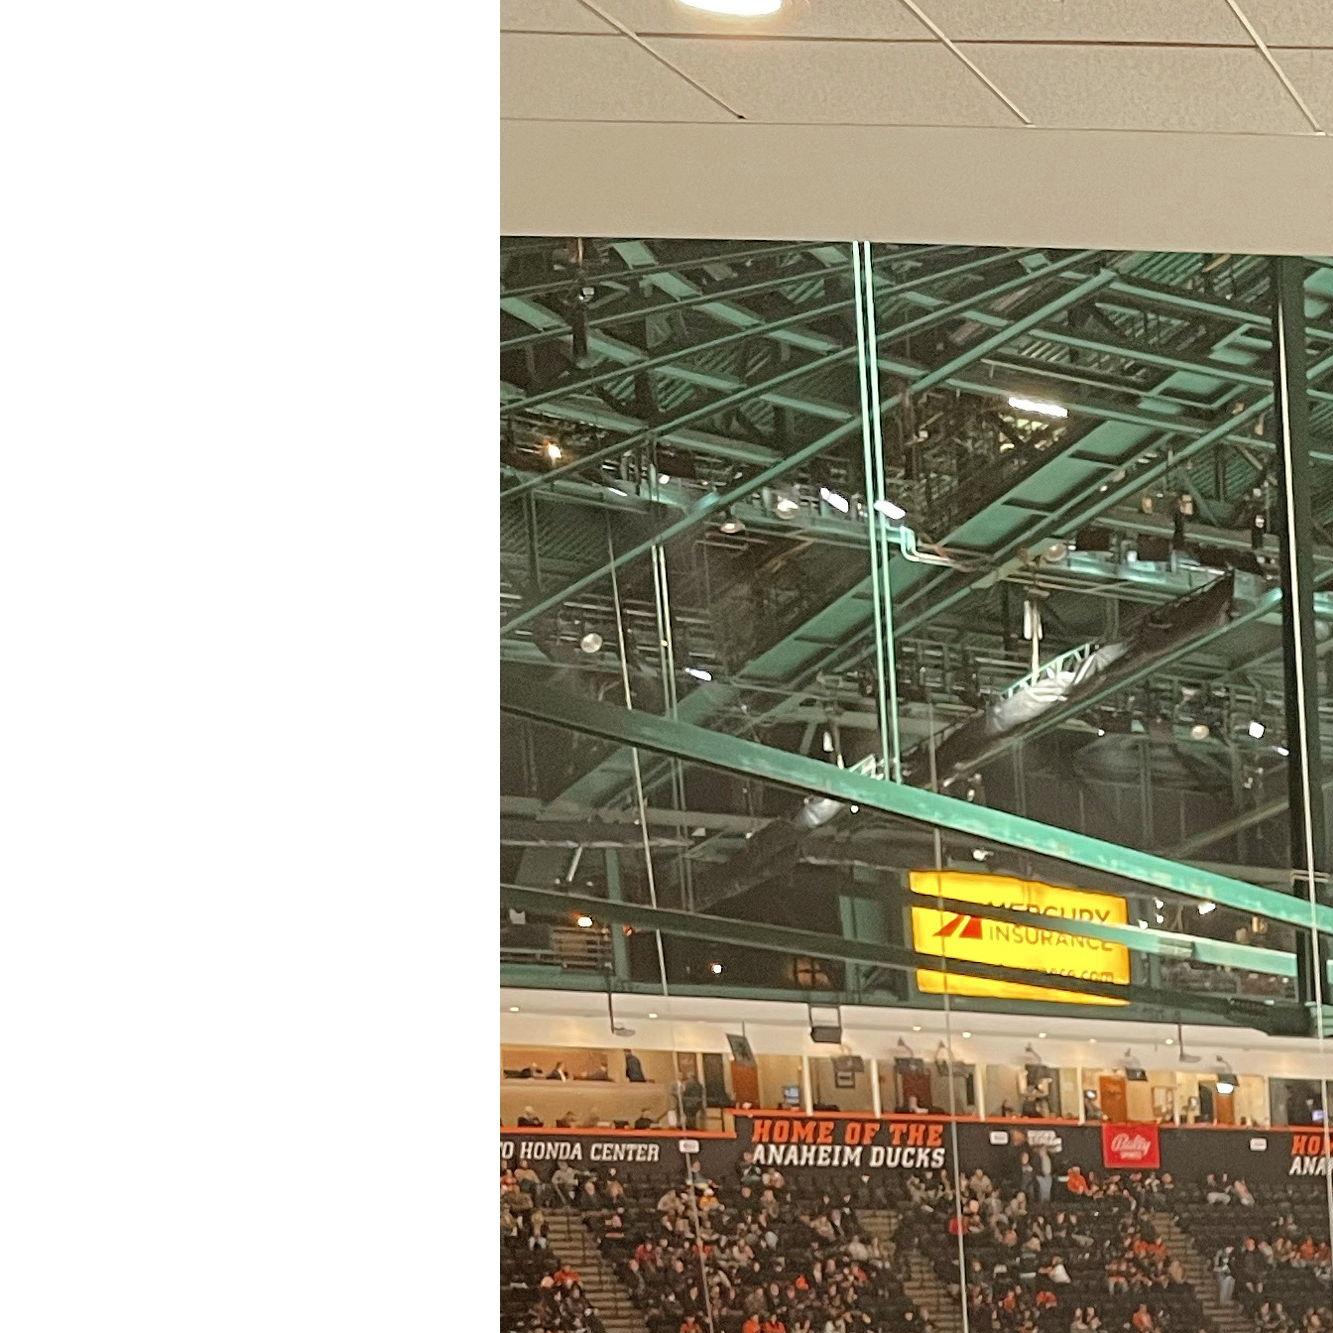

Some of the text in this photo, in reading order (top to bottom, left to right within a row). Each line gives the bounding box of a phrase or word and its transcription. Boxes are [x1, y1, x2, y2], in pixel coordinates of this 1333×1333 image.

[752, 1119, 944, 1147] HOME OF THE
[500, 1141, 660, 1163] O HONDA CENTER
[751, 1144, 946, 1169] ANAHEIM DUCKS
